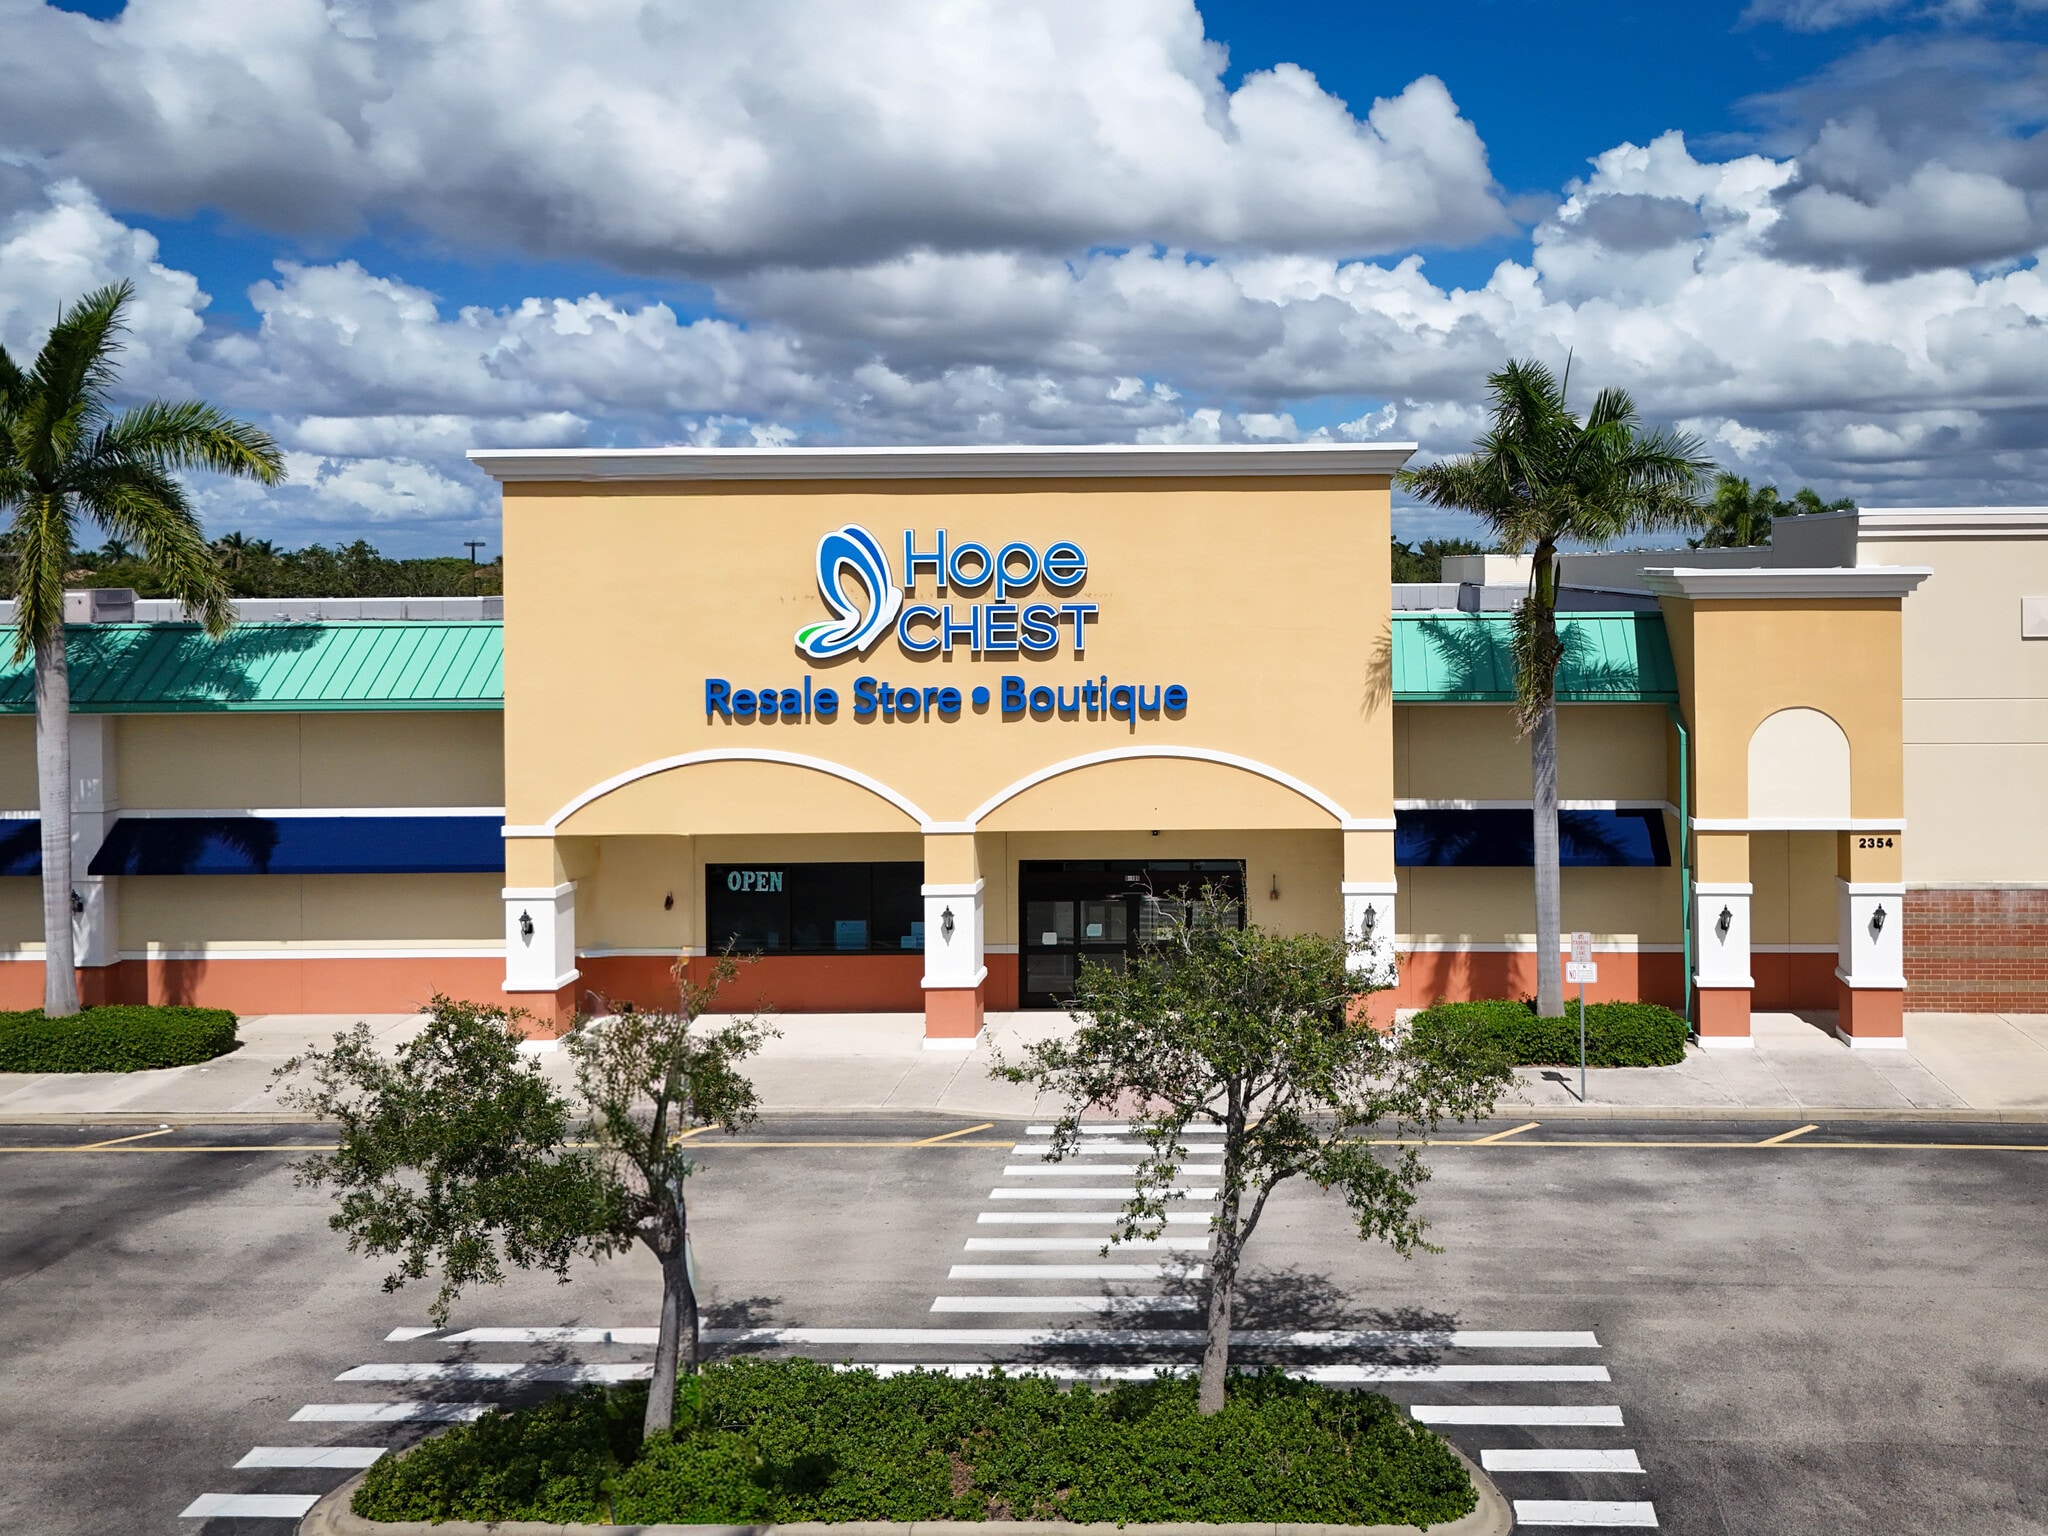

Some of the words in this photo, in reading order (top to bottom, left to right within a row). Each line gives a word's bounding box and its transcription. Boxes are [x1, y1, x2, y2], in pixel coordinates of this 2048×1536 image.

[903, 528, 1088, 601] Hope
[898, 603, 1099, 652] CHEST
[705, 675, 839, 715] Resale
[853, 676, 962, 714] Store
[1001, 675, 1188, 725] Boutique
[1859, 838, 1893, 848] 2354
[728, 871, 784, 891] OPEN
[1569, 969, 1576, 980] NO
